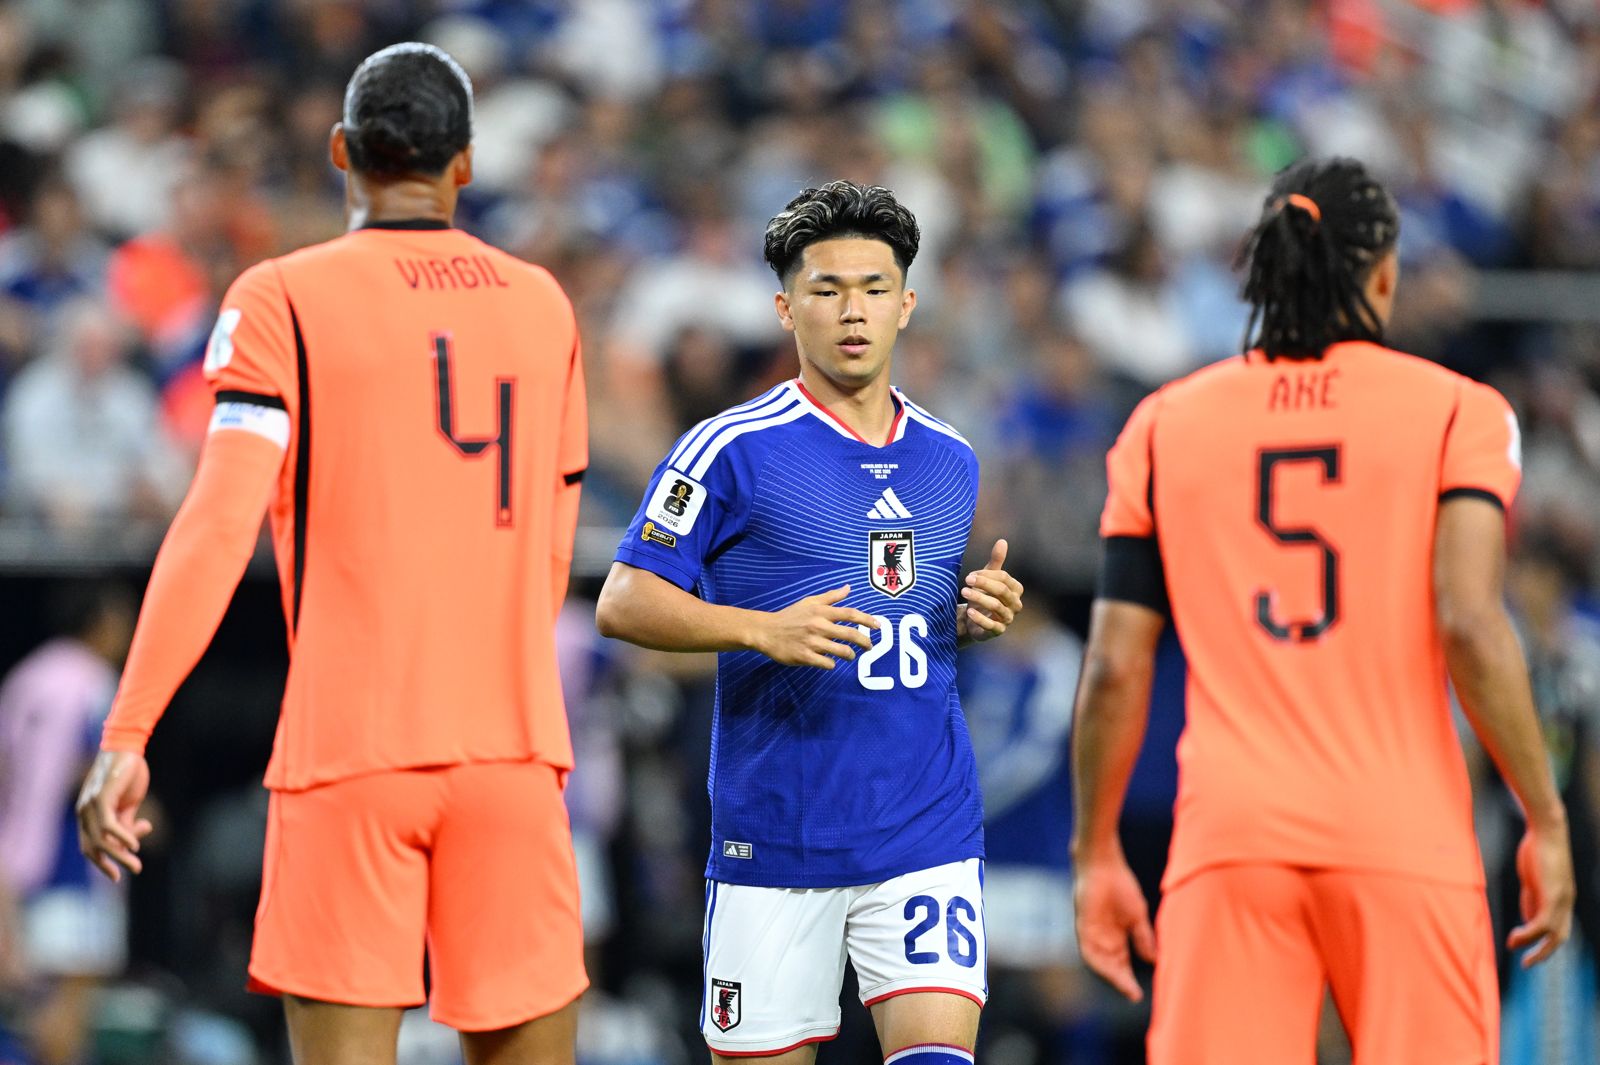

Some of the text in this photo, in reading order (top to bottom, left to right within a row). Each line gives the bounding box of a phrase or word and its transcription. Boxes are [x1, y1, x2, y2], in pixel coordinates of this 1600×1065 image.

[393, 255, 509, 290] VIRGIL
[430, 332, 517, 528] 4
[651, 531, 673, 541] DEBUT
[657, 513, 679, 528] 2026
[1255, 444, 1341, 642] 5
[882, 576, 903, 586] JFA
[858, 614, 928, 690] 26
[904, 895, 977, 968] 26
